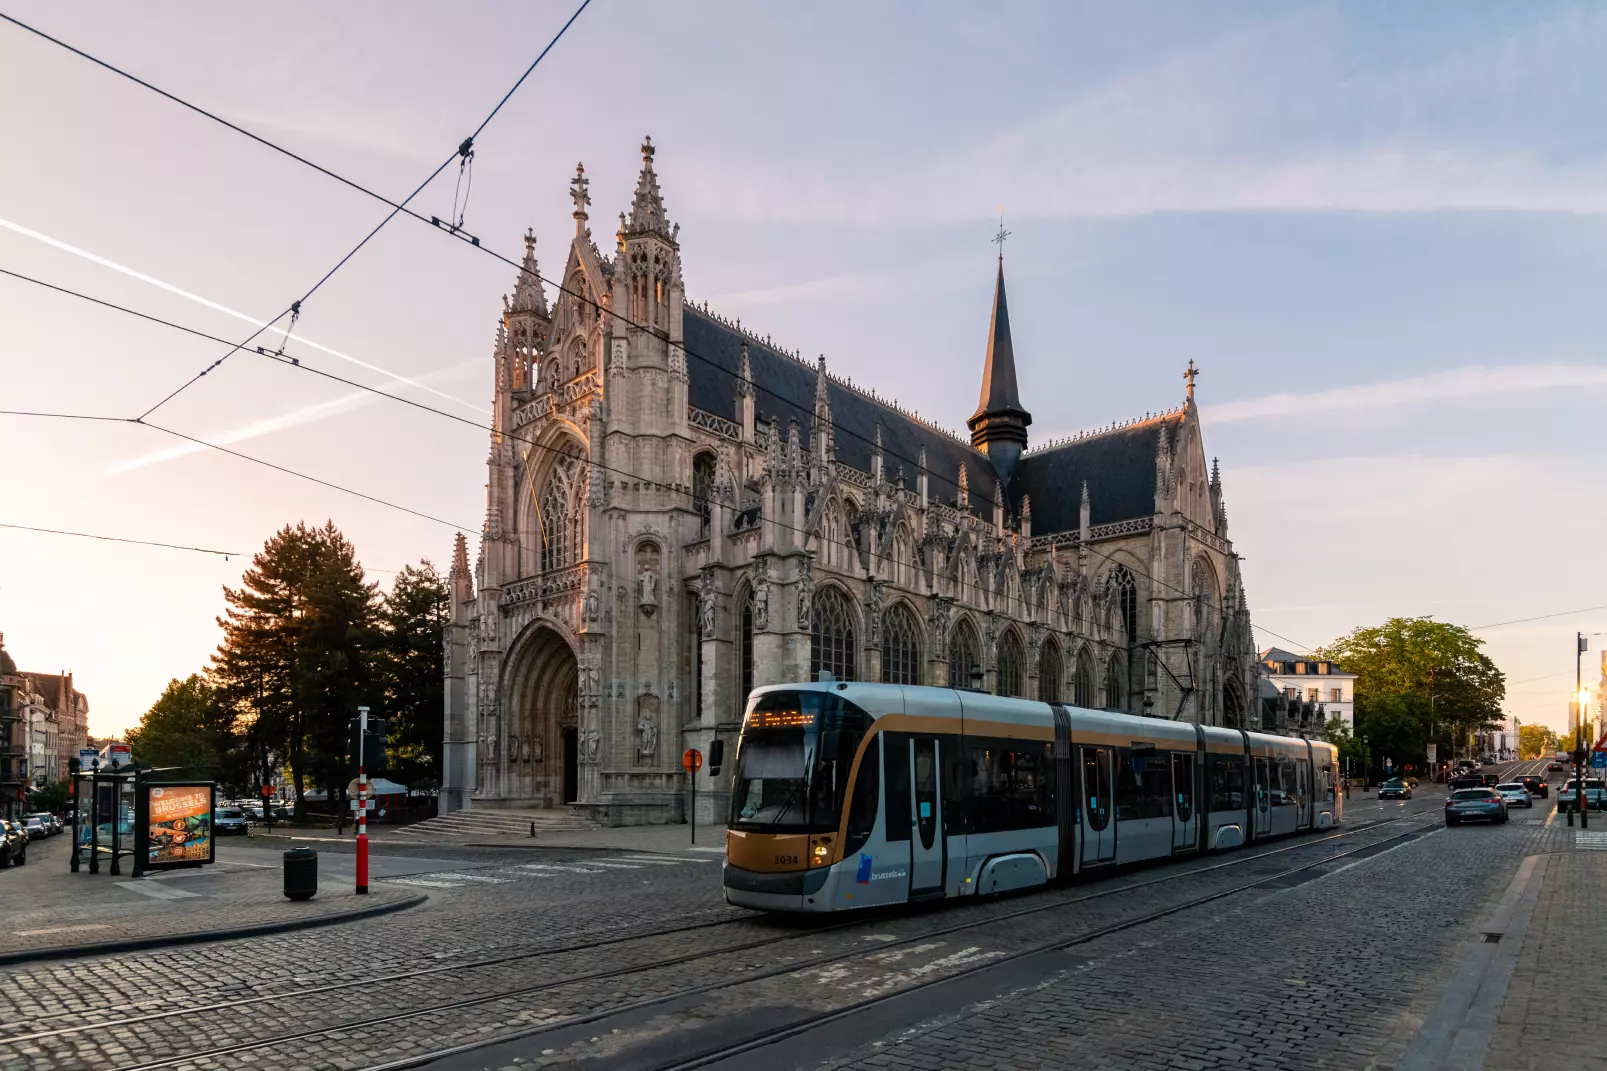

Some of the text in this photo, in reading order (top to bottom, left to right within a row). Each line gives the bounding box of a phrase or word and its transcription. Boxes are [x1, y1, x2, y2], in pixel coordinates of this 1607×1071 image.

[151, 794, 193, 808] WELCOME
[154, 797, 207, 814] BRUSSELS
[774, 855, 798, 865] 3034
